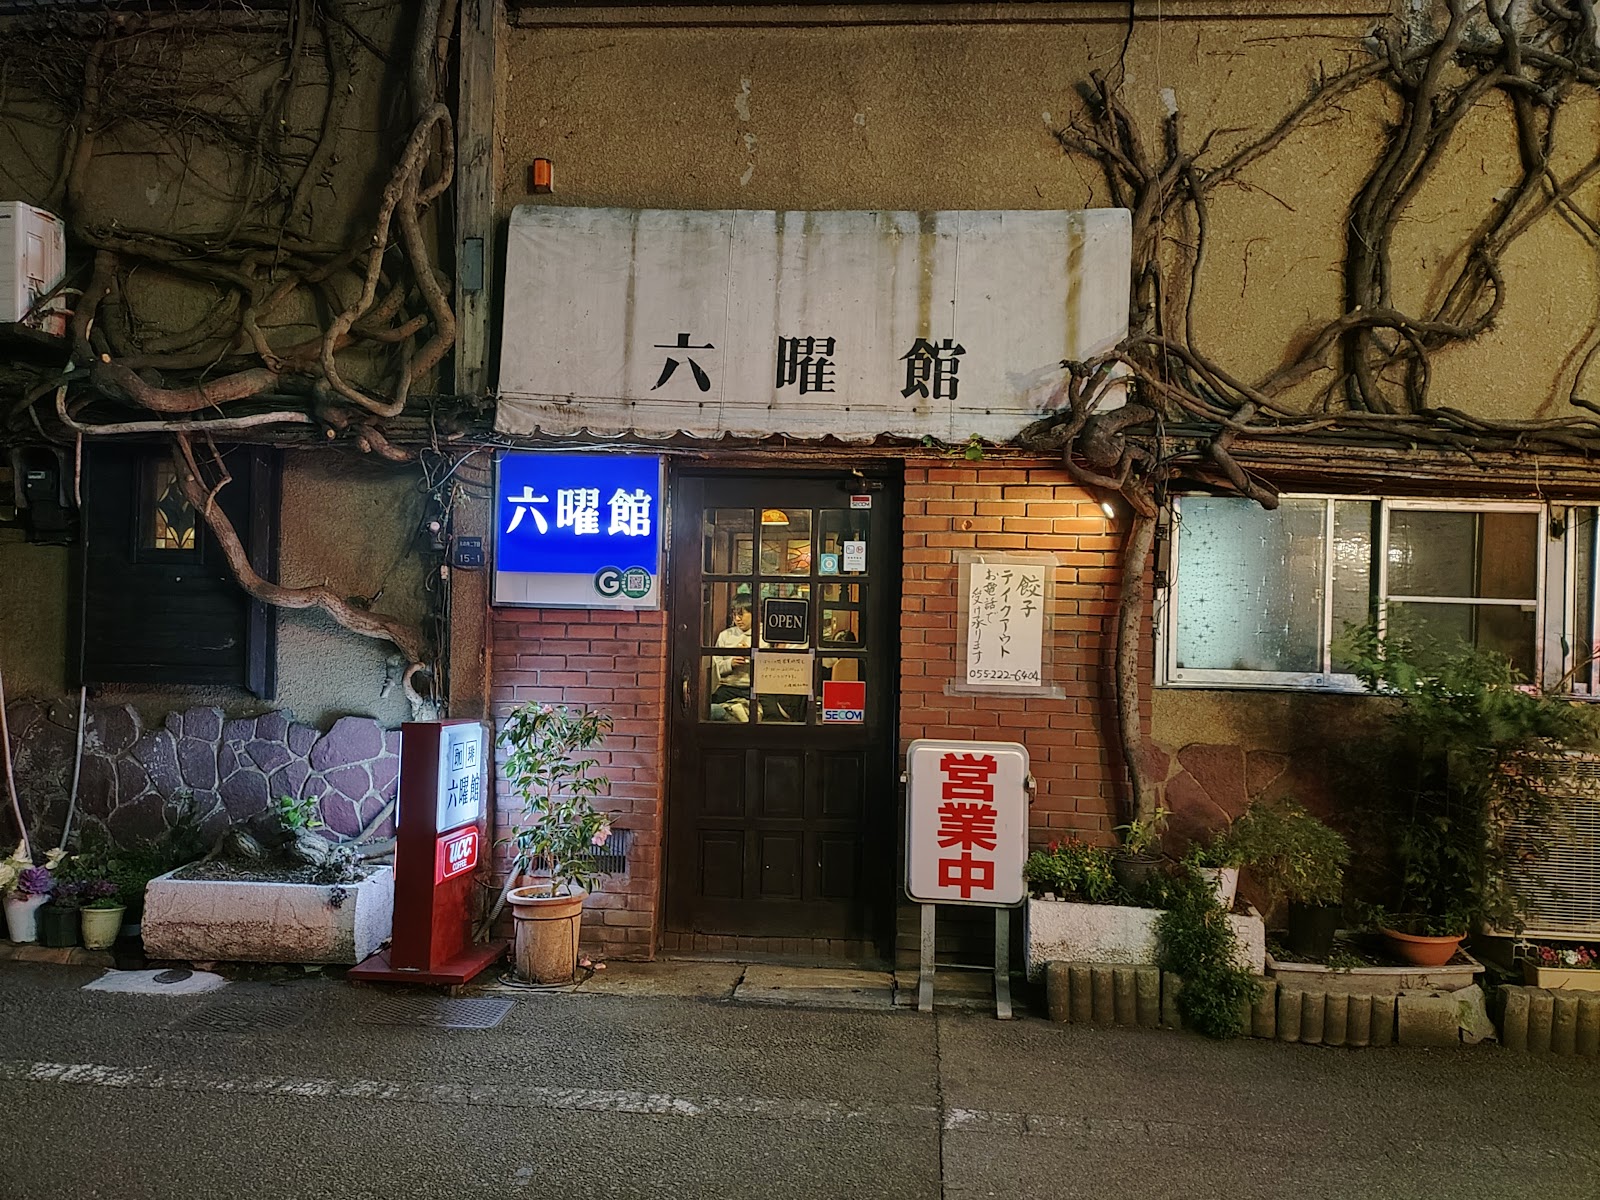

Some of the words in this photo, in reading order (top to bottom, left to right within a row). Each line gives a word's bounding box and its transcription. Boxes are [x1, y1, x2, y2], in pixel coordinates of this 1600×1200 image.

[650, 333, 966, 400] 六曜館
[506, 486, 652, 537] 六曜館
[460, 554, 480, 563] 15-1
[598, 571, 620, 594] G
[983, 568, 999, 623] お電話で
[1016, 574, 1042, 618] 餃子
[768, 613, 803, 629] OPEN
[999, 569, 1013, 658] テイクアウト
[969, 669, 1042, 682] 055-222-6404
[825, 710, 862, 720] SECOM
[454, 744, 475, 766] 珈琲
[447, 772, 480, 810] 六曜館
[937, 752, 998, 899] 営業中
[450, 836, 473, 863] UCC
